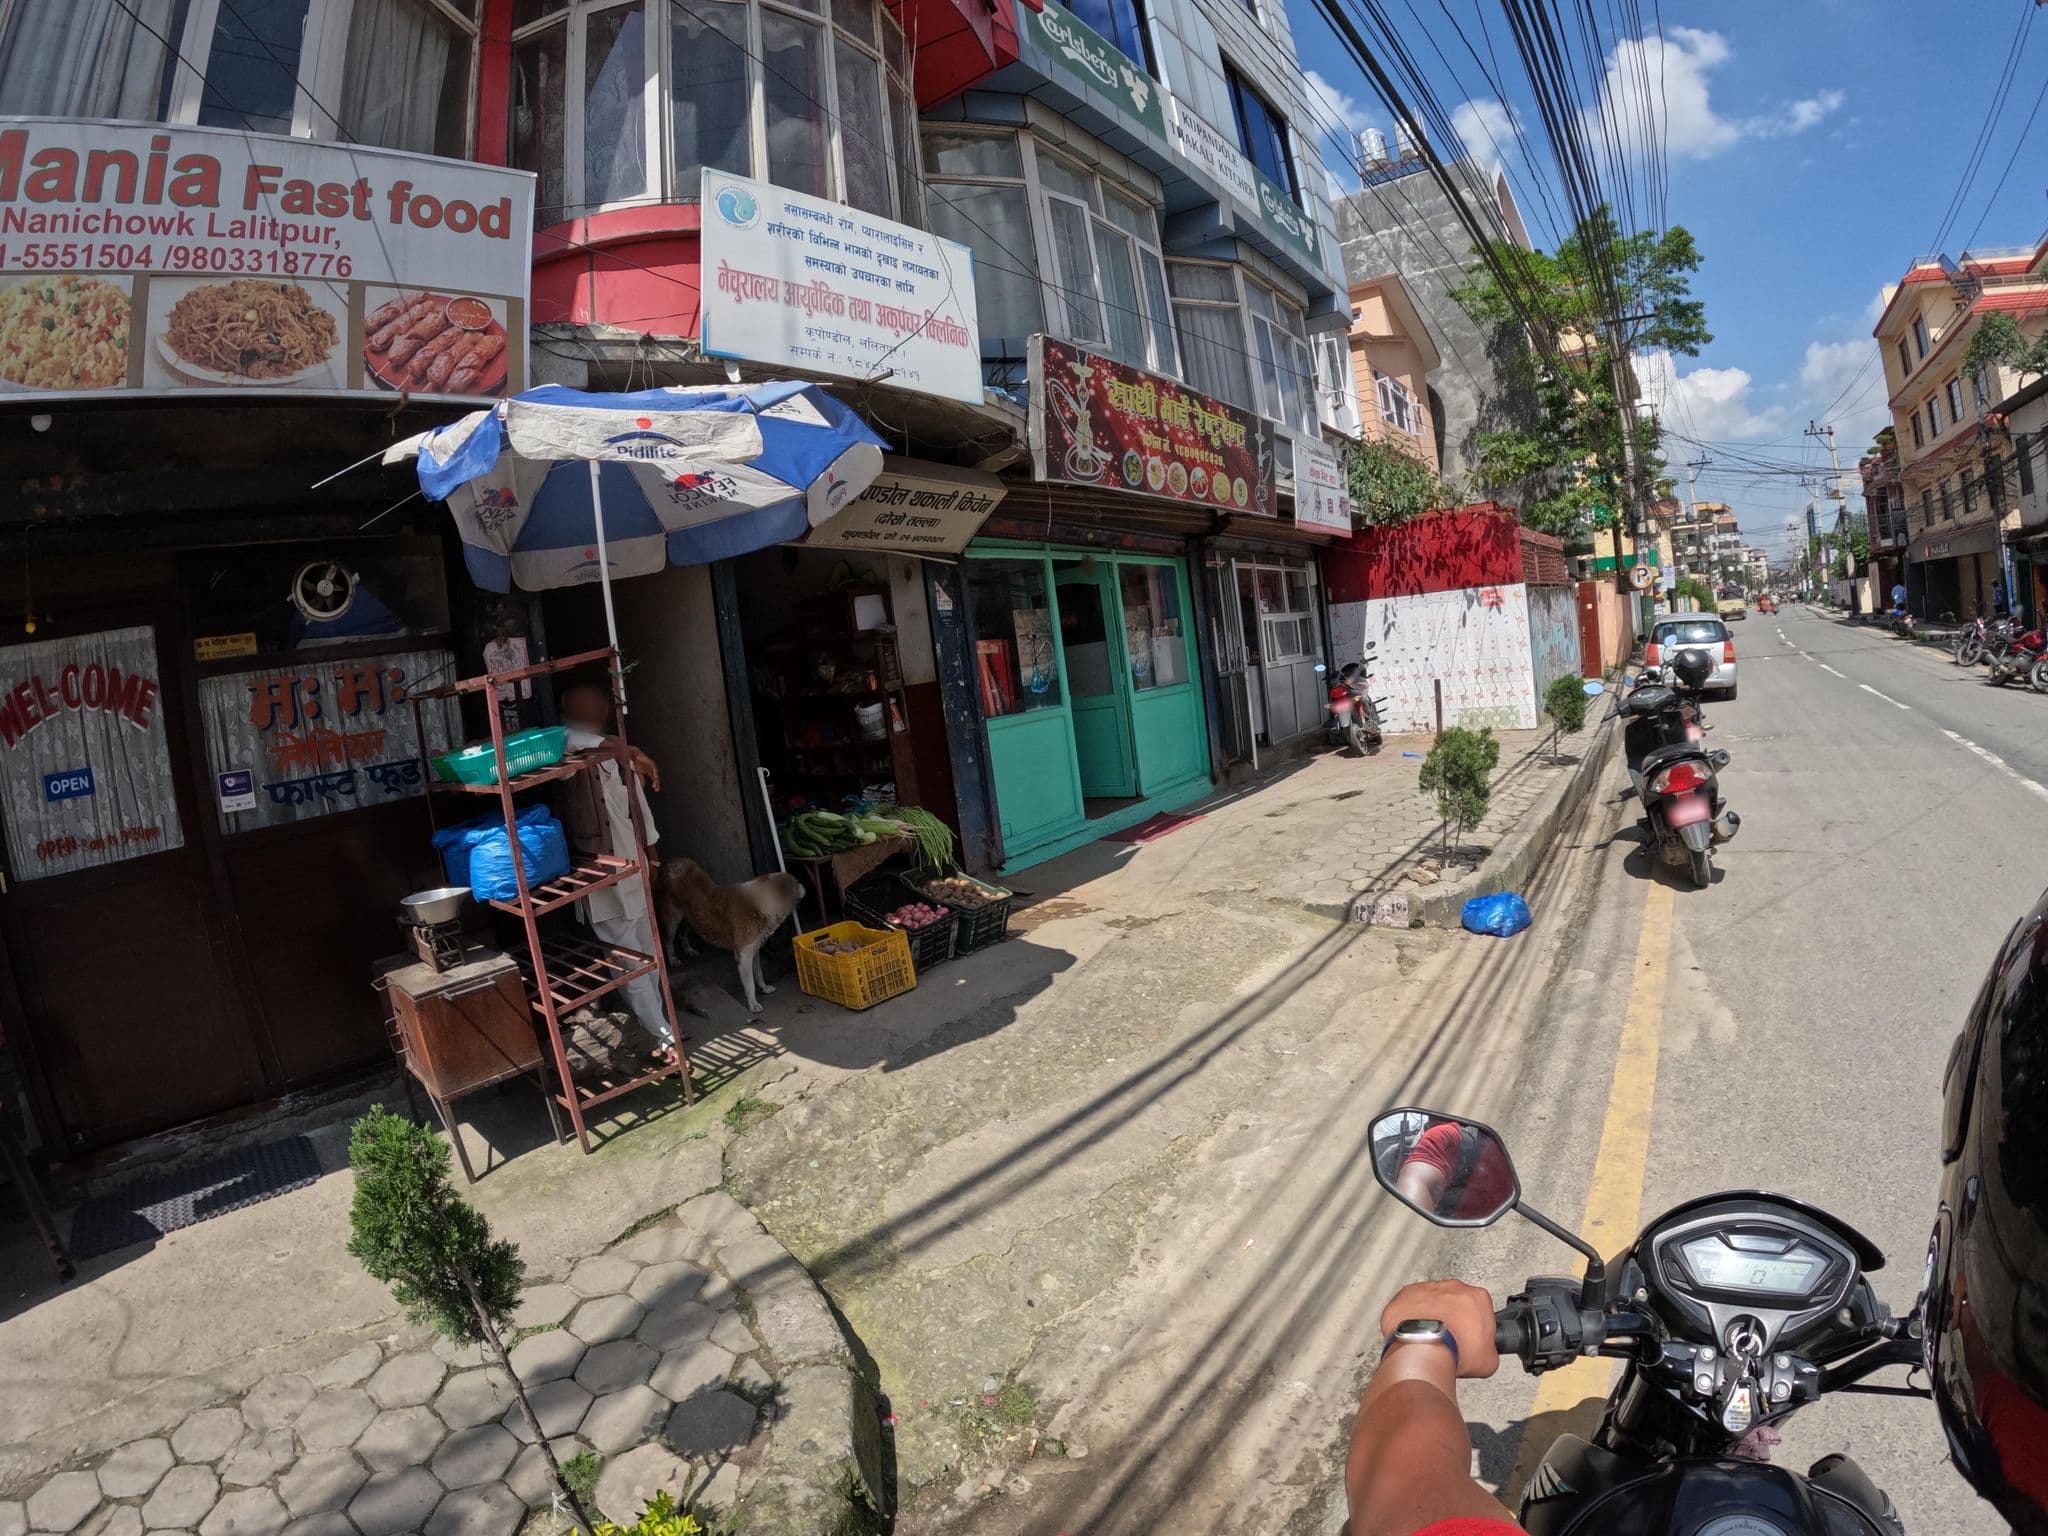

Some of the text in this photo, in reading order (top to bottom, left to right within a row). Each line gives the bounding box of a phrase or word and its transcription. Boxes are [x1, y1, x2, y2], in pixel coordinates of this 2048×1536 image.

[1037, 3, 1118, 88] Carlsberg
[1182, 111, 1238, 167] KUPANDOLE
[1218, 159, 1255, 199] KITCHEN
[243, 165, 372, 220] Fast
[388, 181, 511, 240] food
[1261, 183, 1299, 236] Carlsberg
[2, 206, 341, 248] Nanichowk Lalitpur,
[767, 222, 805, 241] शरीरको
[844, 242, 872, 260] भागको
[162, 245, 353, 278] /9803318776
[895, 280, 915, 294] लागि
[848, 296, 871, 323] तथा
[50, 775, 90, 795] OPEN
